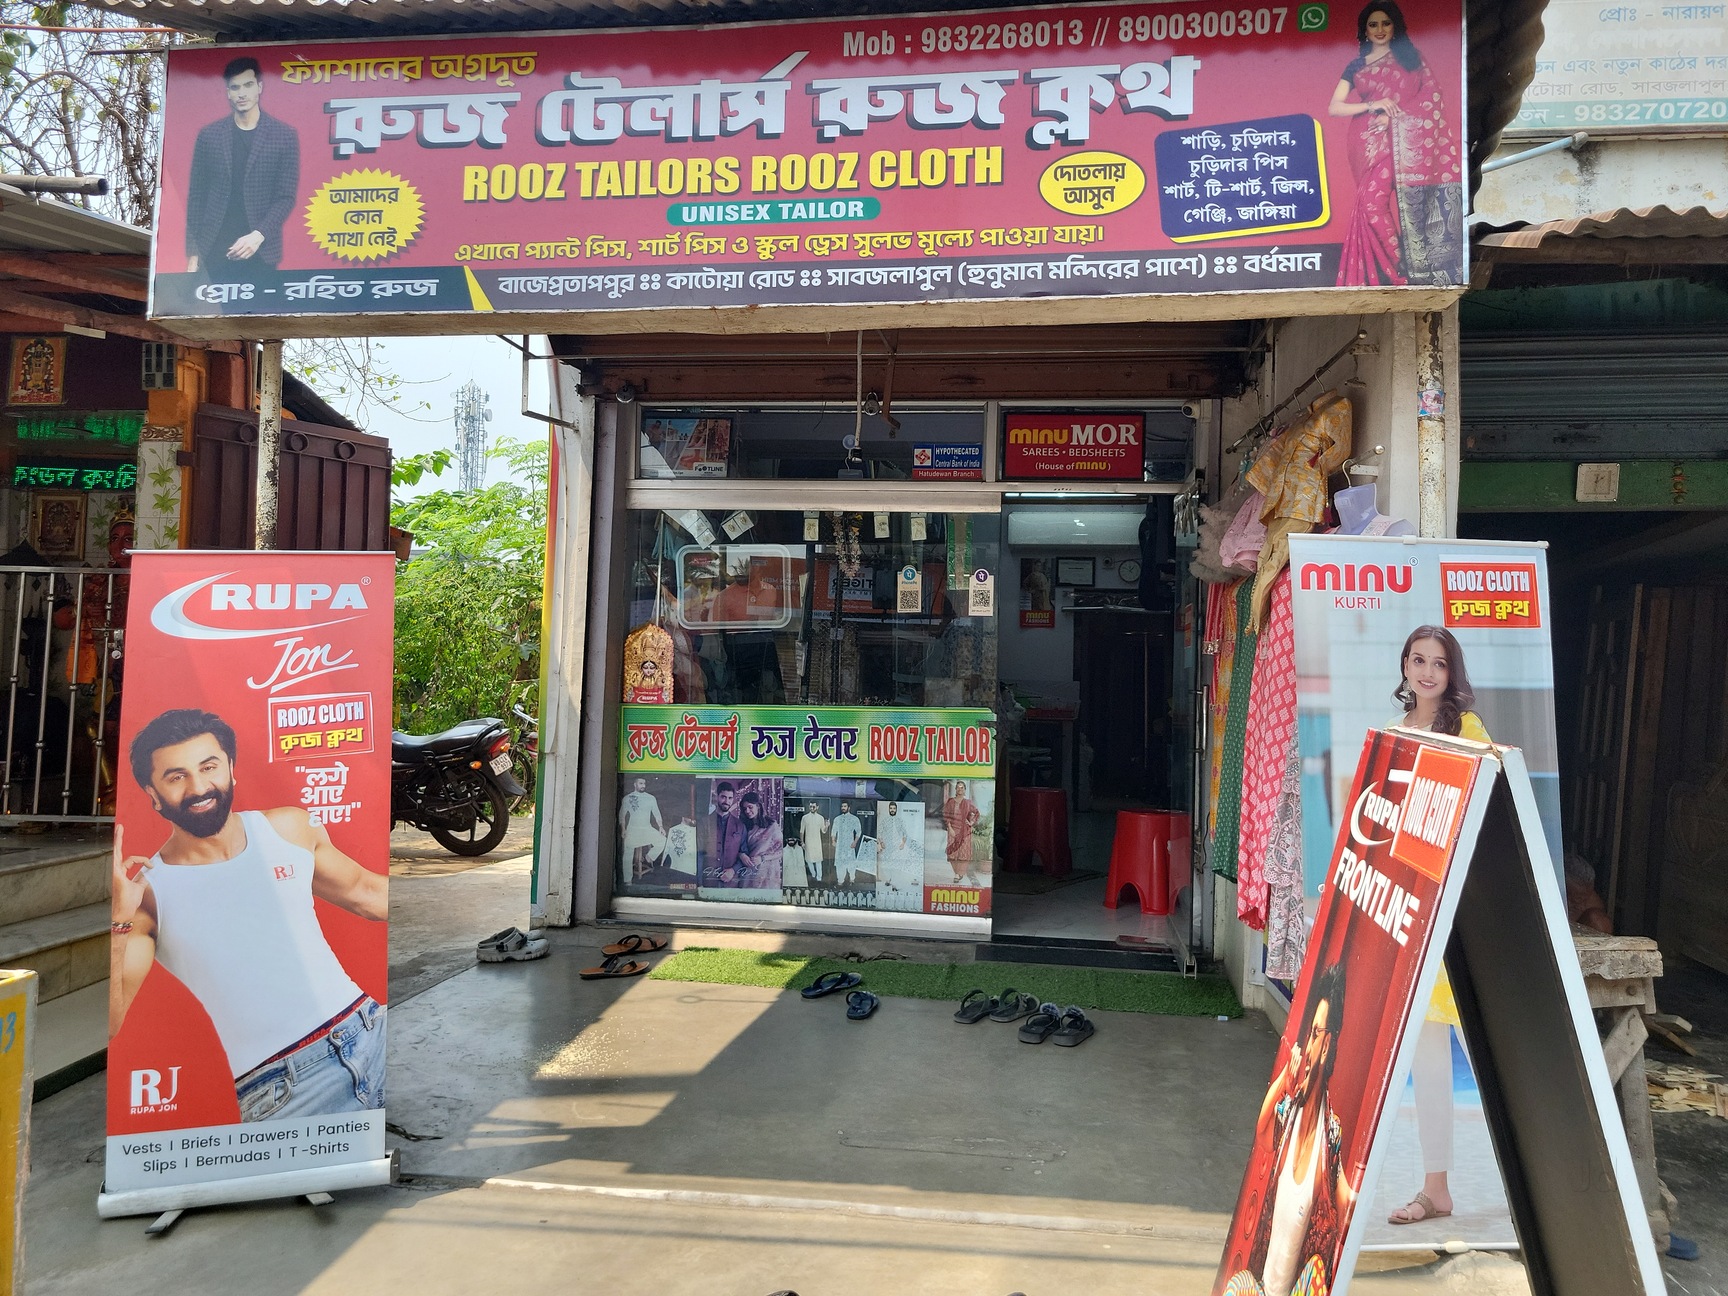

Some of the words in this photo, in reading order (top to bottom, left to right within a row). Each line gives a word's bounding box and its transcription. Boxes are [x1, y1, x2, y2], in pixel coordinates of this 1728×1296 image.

[1662, 4, 1726, 19] নারায়ণ
[843, 31, 895, 57] Mob
[920, 20, 1084, 54] 9832268013
[1118, 7, 1288, 42] 8900300307
[281, 57, 423, 85] ফ্যাশানের
[430, 52, 538, 87] অগ্রদূত
[1562, 60, 1597, 74] এবং
[1603, 58, 1641, 76] নতুন
[1649, 51, 1699, 71] কাঠের
[328, 92, 521, 157] রুজ
[542, 51, 810, 144] টেলার্স
[811, 70, 1019, 139] রুজ
[1030, 55, 1201, 146] ক্লথ
[1180, 130, 1226, 151] শাড়ি,
[1230, 127, 1296, 152] চুড়িদার,
[463, 162, 566, 201] ROOZ
[576, 156, 741, 198] TAILORS
[751, 152, 859, 192] ROOZ
[869, 146, 1003, 188] CLOTH
[1053, 162, 1126, 183] দোতলায়
[1188, 155, 1248, 179] চুড়িদার
[1252, 152, 1289, 172] পিস
[329, 187, 400, 205] আমাদের
[1063, 185, 1116, 211] আসুন
[1163, 179, 1200, 200] শার্ট,
[343, 208, 383, 226] কোন
[682, 204, 771, 223] UNISEX
[778, 200, 865, 220] TAILOR
[1236, 200, 1298, 222] জাঙ্গিয়া
[327, 232, 366, 248] শাখা
[367, 227, 398, 249] নেই
[454, 240, 521, 262] এখানে
[525, 236, 581, 261] প্যান্ট
[584, 235, 632, 261] পিস,
[638, 231, 682, 256] শার্ট
[684, 231, 726, 256] পিস
[731, 236, 749, 254] ও
[755, 233, 799, 260] স্কুল
[805, 231, 848, 254] ড্রেস
[853, 230, 912, 258] সুলভ
[917, 228, 975, 257] মূল্যে
[979, 226, 1048, 249] পাওয়া
[1052, 225, 1105, 246] যায়।
[498, 273, 634, 299] বাজেপ্রতাপপুর
[666, 266, 743, 291] কাটোয়া
[748, 269, 795, 290] রোড
[827, 263, 952, 290] সাবজলাপুল
[1048, 254, 1139, 280] মন্দিরের
[1146, 254, 1208, 278] পাশে)
[1243, 246, 1322, 273] বর্ধমান
[196, 281, 256, 304] প্রোঃ
[284, 275, 365, 301] রহিত
[371, 278, 439, 299] রুজ
[936, 447, 979, 455] HYPOTHECATED
[1023, 448, 1060, 457] SAREES
[1068, 448, 1126, 457] BEDSHEETS
[1035, 461, 1064, 471] (House
[1066, 462, 1075, 470] of
[1447, 571, 1483, 592] ROOZ
[1486, 571, 1529, 592] CLOTH
[211, 583, 368, 610] RUPA
[1334, 596, 1381, 609] KURTI
[1450, 600, 1491, 620] রুজ
[1494, 600, 1529, 619] ক্লথ
[247, 637, 353, 689] Jon
[278, 706, 316, 728] ROOZ
[318, 701, 364, 724] CLOTH
[280, 732, 322, 754] রুজ
[326, 727, 363, 748] ক্লথ
[628, 725, 668, 760] রুজ
[675, 714, 739, 762] টেলার্স
[751, 726, 796, 758] रुज
[803, 714, 858, 761] टेलर
[870, 726, 919, 761] ROOZ
[925, 727, 991, 763] TAILOR
[301, 784, 345, 805] आए
[274, 865, 294, 879] RJ
[931, 903, 979, 913] FASHIONS
[1333, 847, 1420, 947] FRONTLINE
[130, 1067, 183, 1107] RJ
[130, 1105, 156, 1115] RUPA
[158, 1103, 178, 1113] JON
[122, 1142, 162, 1156] Vests
[181, 1135, 221, 1151] Briefs
[240, 1130, 299, 1145] Drawers
[317, 1120, 371, 1137] Panties
[143, 1157, 177, 1172] Slips
[196, 1150, 270, 1167] Bermudas
